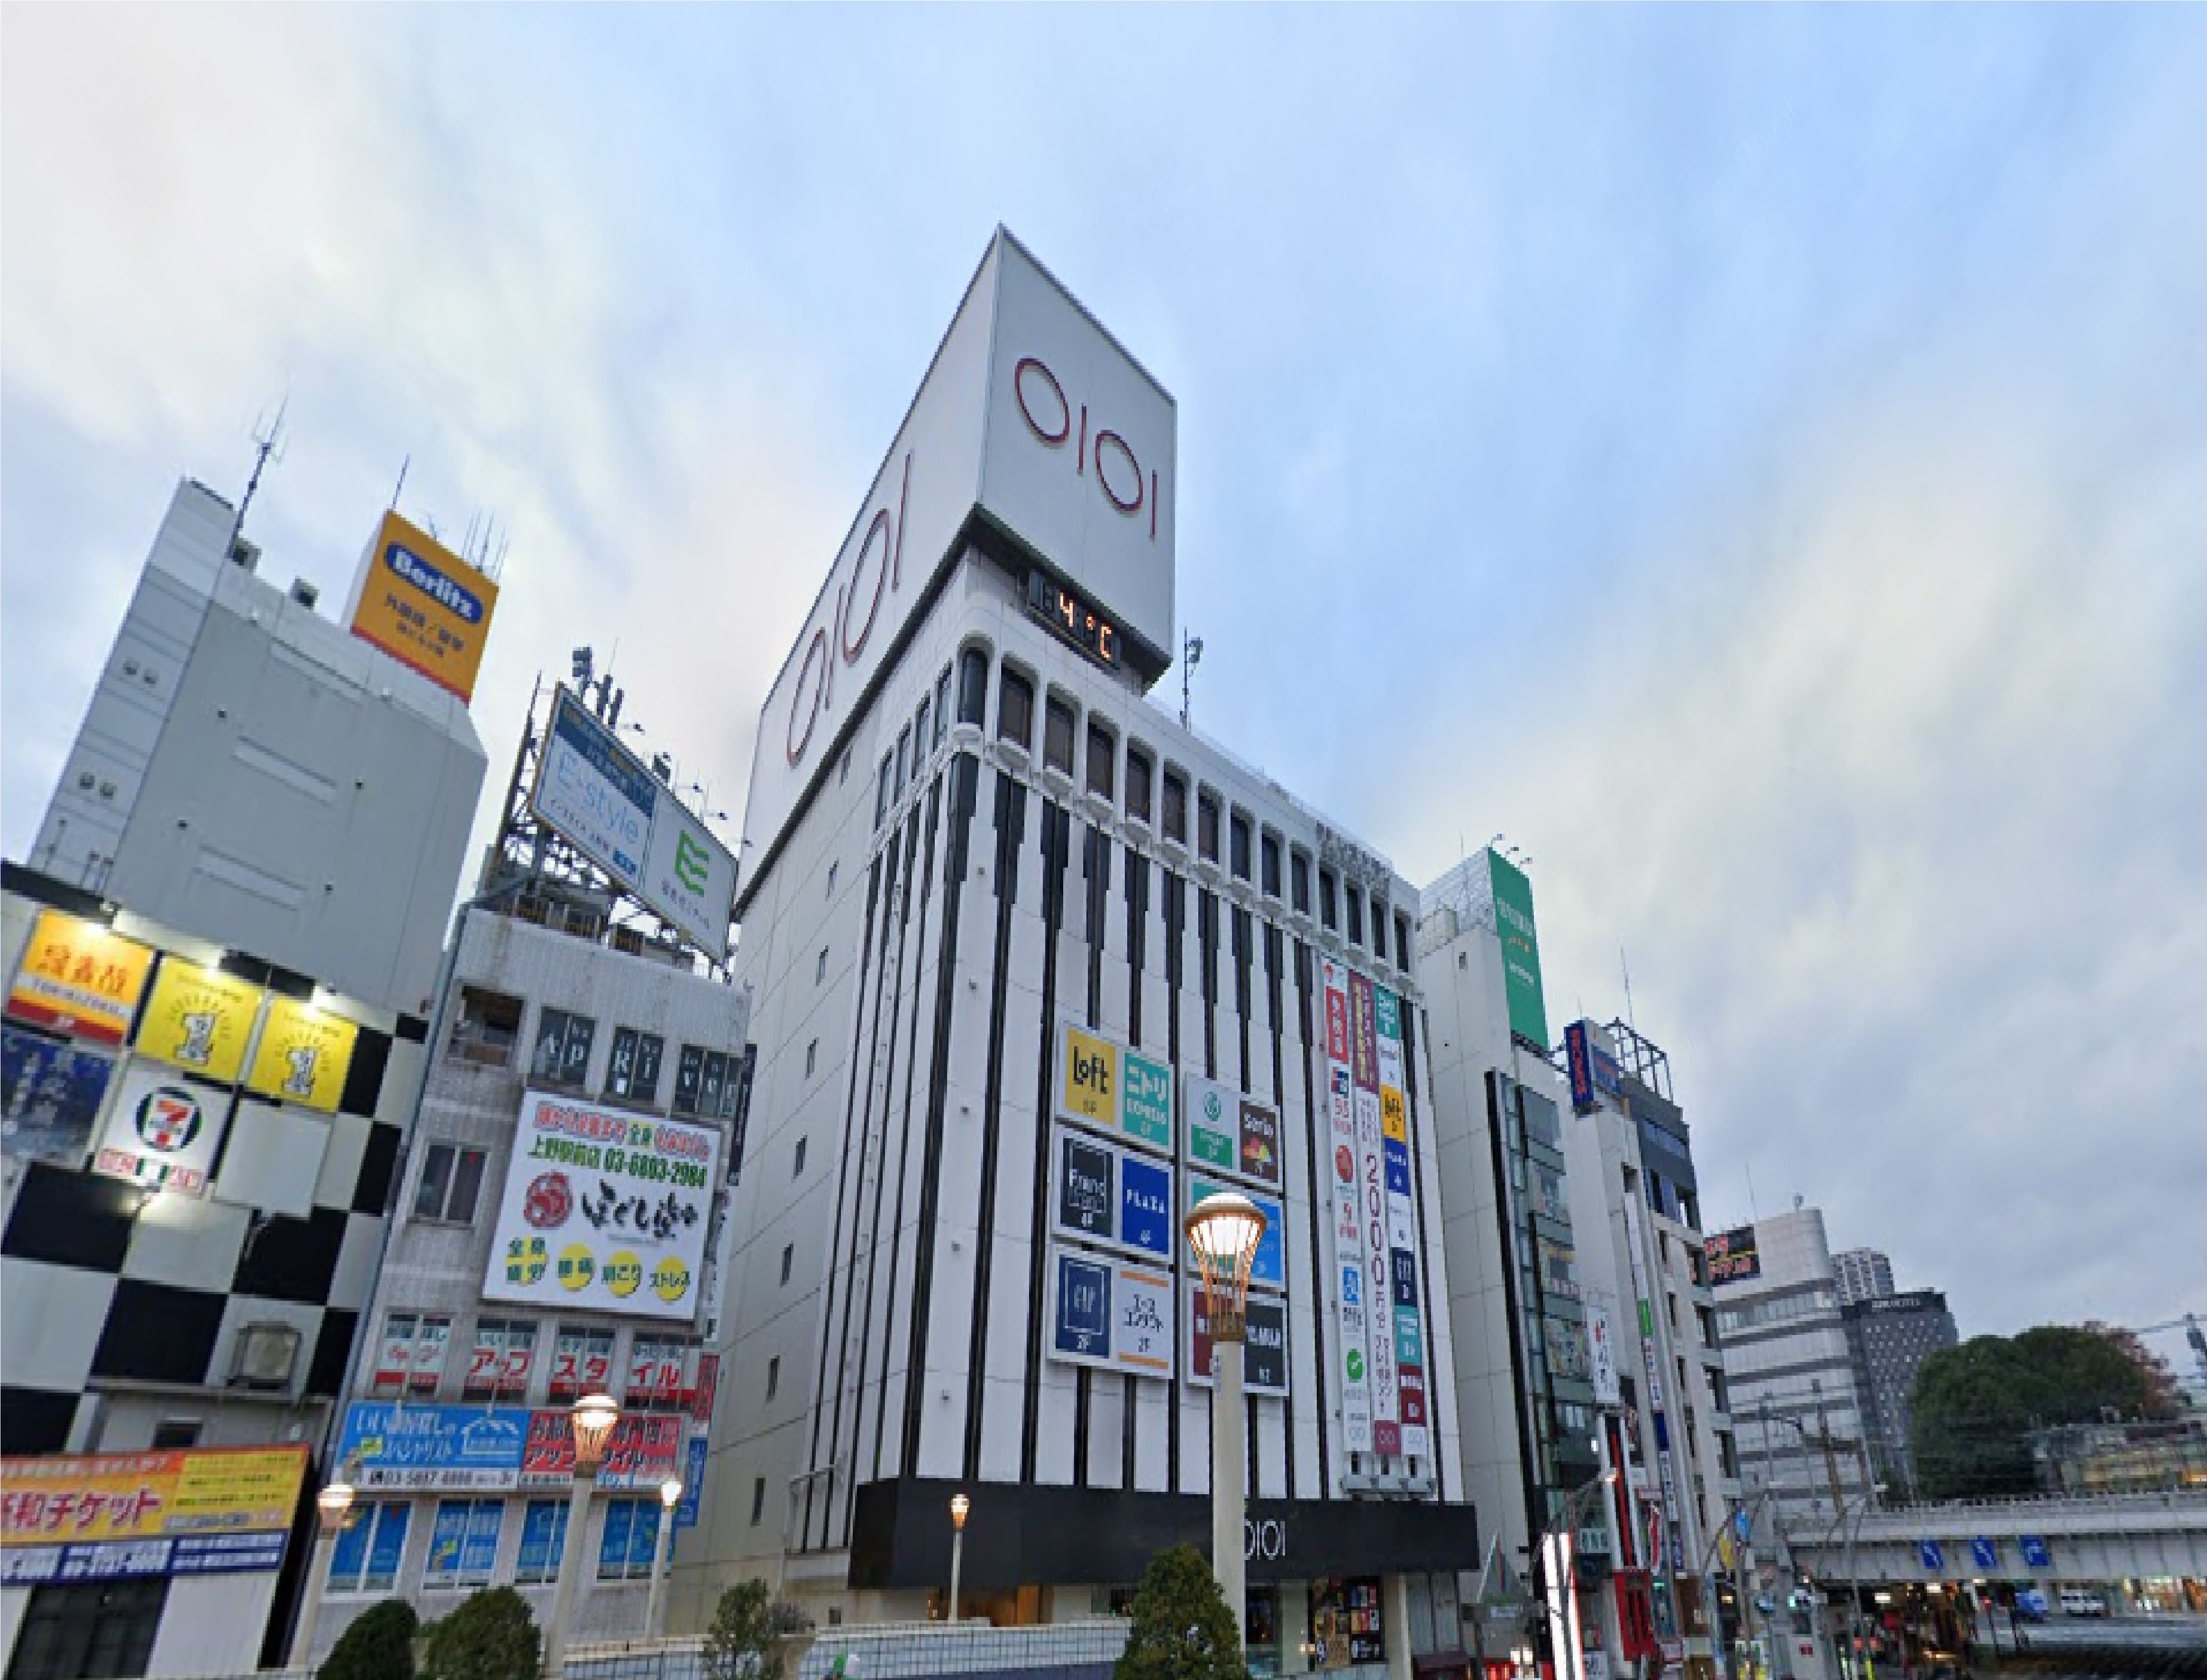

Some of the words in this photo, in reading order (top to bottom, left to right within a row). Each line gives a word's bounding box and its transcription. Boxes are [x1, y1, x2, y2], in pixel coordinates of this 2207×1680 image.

[394, 550, 473, 618] Berlitz
[1074, 1046, 1108, 1094] Loft
[1127, 1065, 1166, 1104] ニトリ
[1127, 1188, 1165, 1214] PLAZA
